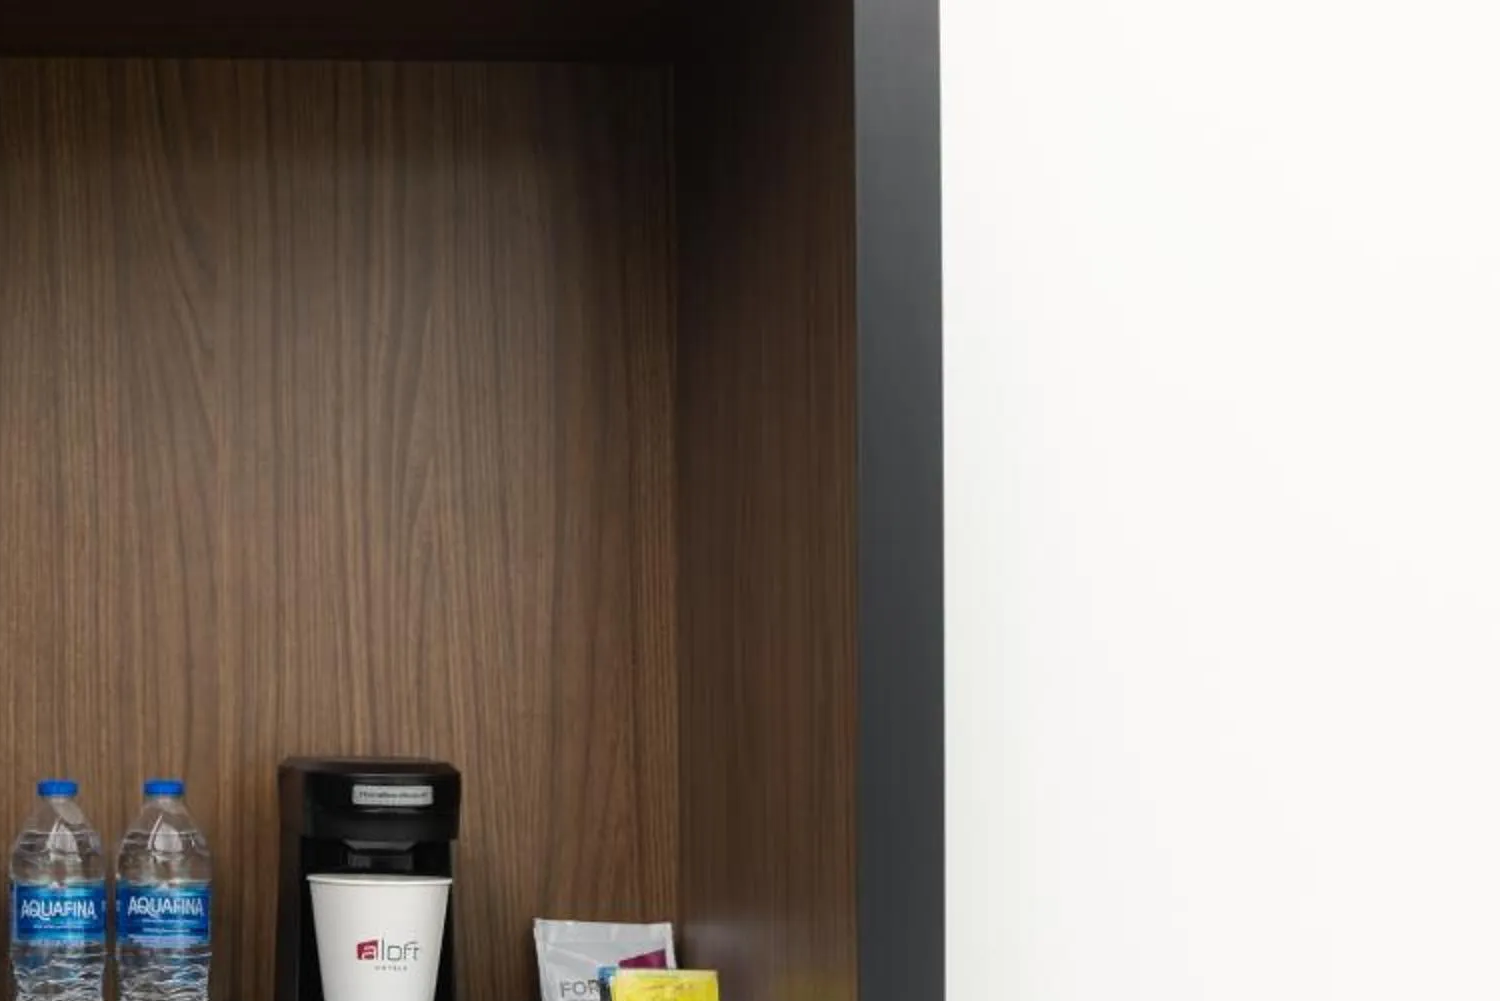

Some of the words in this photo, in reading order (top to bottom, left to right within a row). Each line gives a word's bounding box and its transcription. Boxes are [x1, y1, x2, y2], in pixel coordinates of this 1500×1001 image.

[20, 899, 98, 920] AQUAFINA
[127, 895, 205, 918] AQUAFINA
[356, 937, 420, 961] aloft
